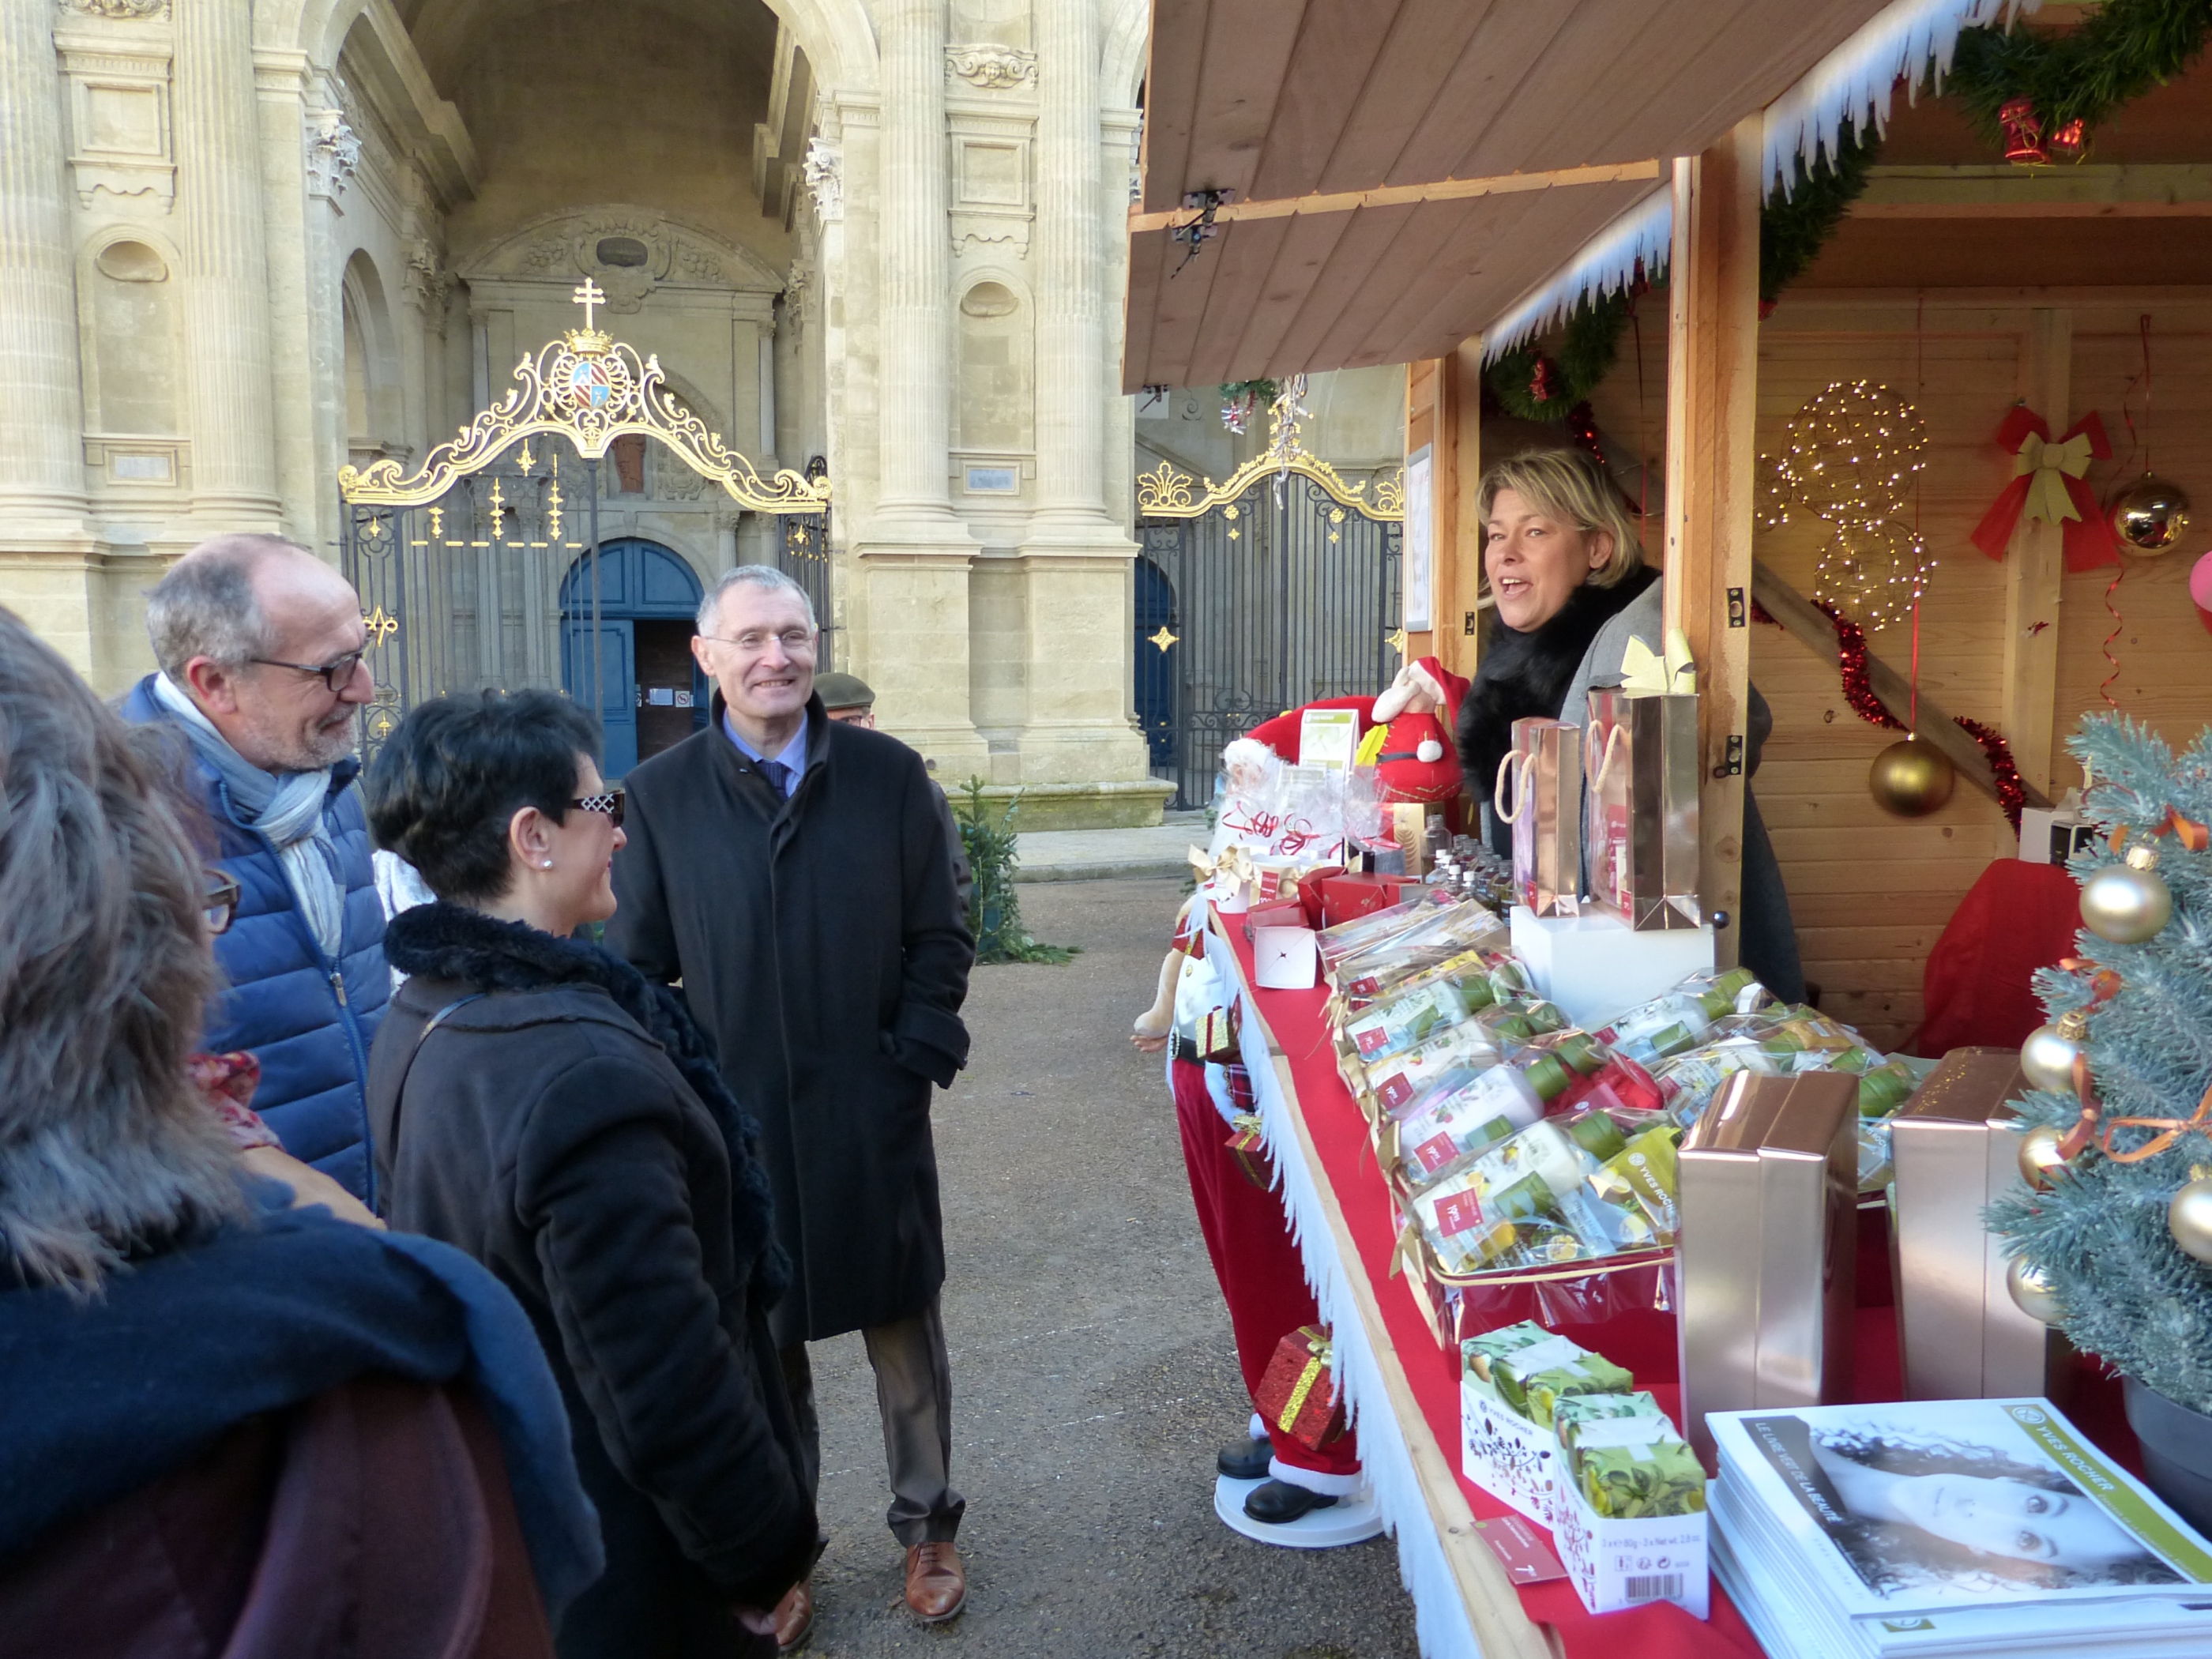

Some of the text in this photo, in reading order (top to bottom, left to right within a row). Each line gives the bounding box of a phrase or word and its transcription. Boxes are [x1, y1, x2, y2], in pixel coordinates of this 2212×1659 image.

[1639, 1165, 1658, 1188] YVES
[1755, 1422, 1845, 1523] LE LIVRE VERT DE LA BEAUTÉ
[2036, 1425, 2116, 1492] YVES ROCHER
